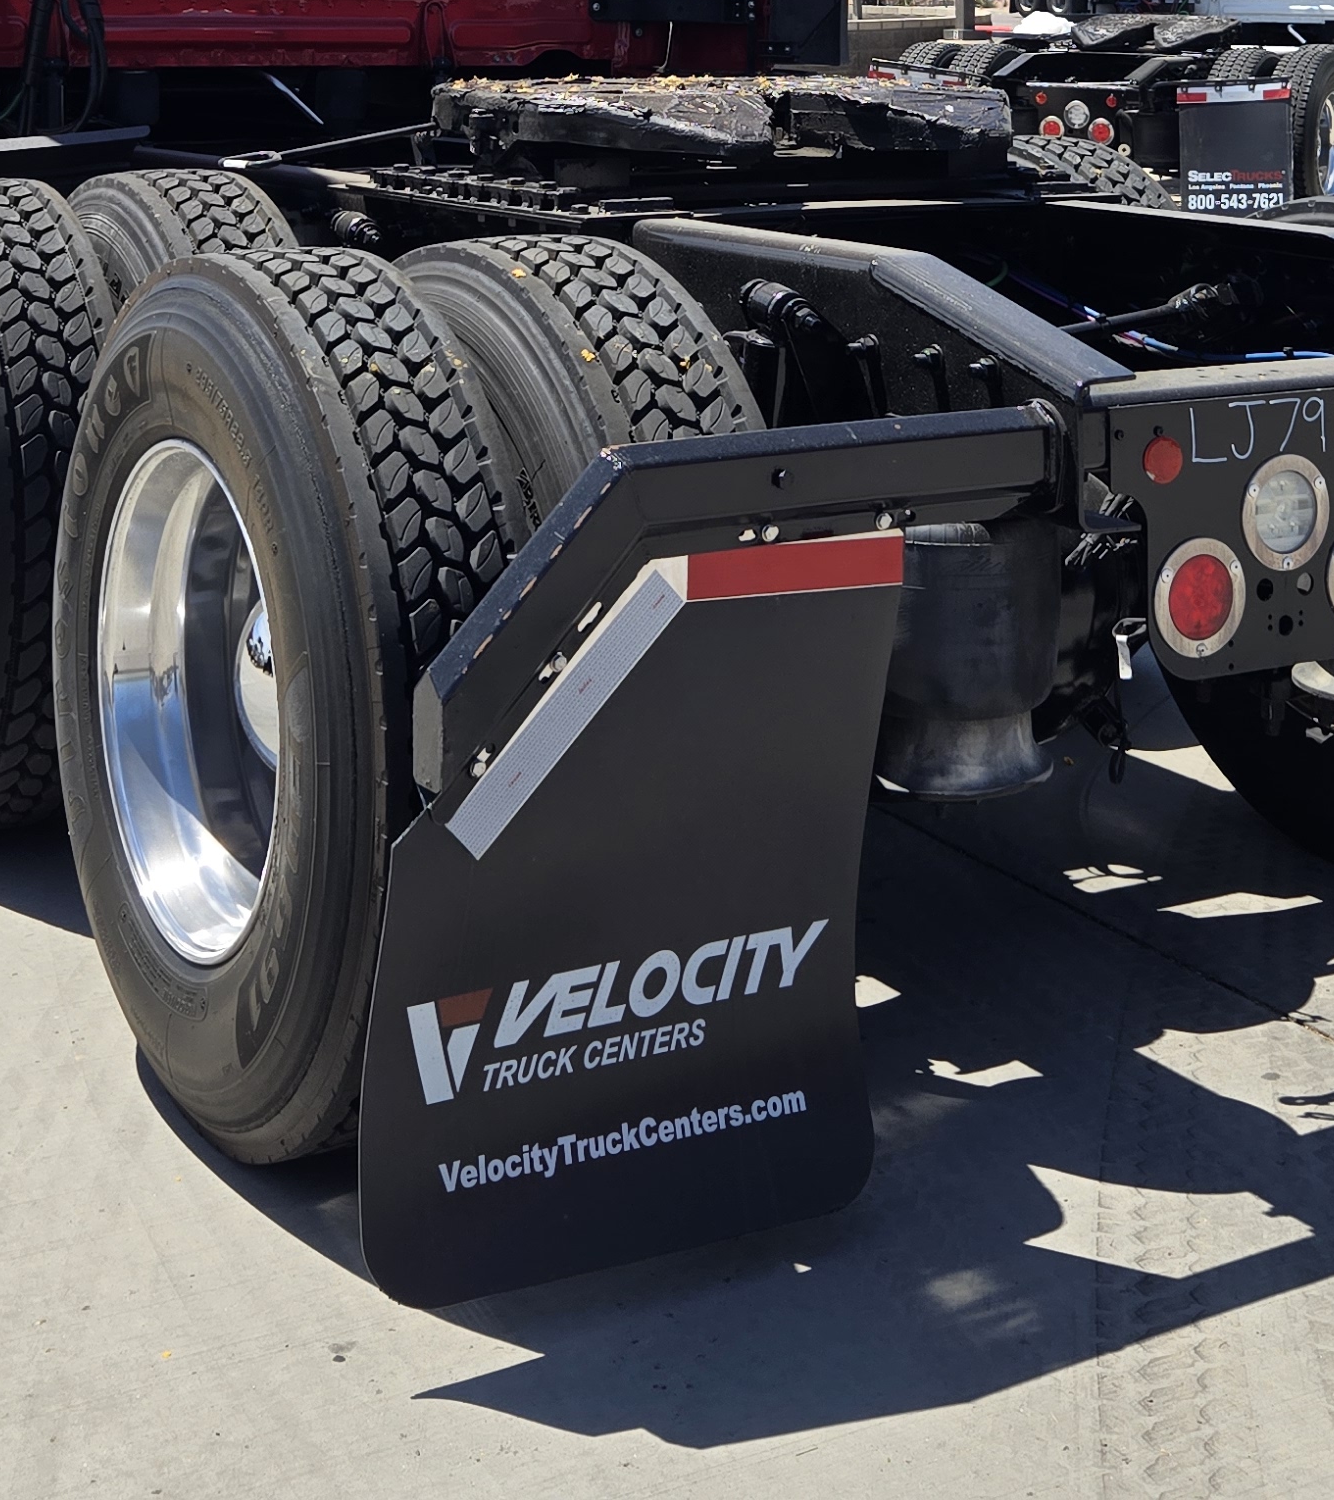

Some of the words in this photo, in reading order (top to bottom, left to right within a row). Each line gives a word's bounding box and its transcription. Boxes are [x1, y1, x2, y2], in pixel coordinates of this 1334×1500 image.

[1187, 192, 1284, 210] 800-543-7621
[493, 918, 830, 1049] VELOCITY
[482, 1045, 577, 1092] TRUCK
[582, 1018, 706, 1071] CENTERS
[438, 1090, 807, 1193] VelocityTruckCenters.com
